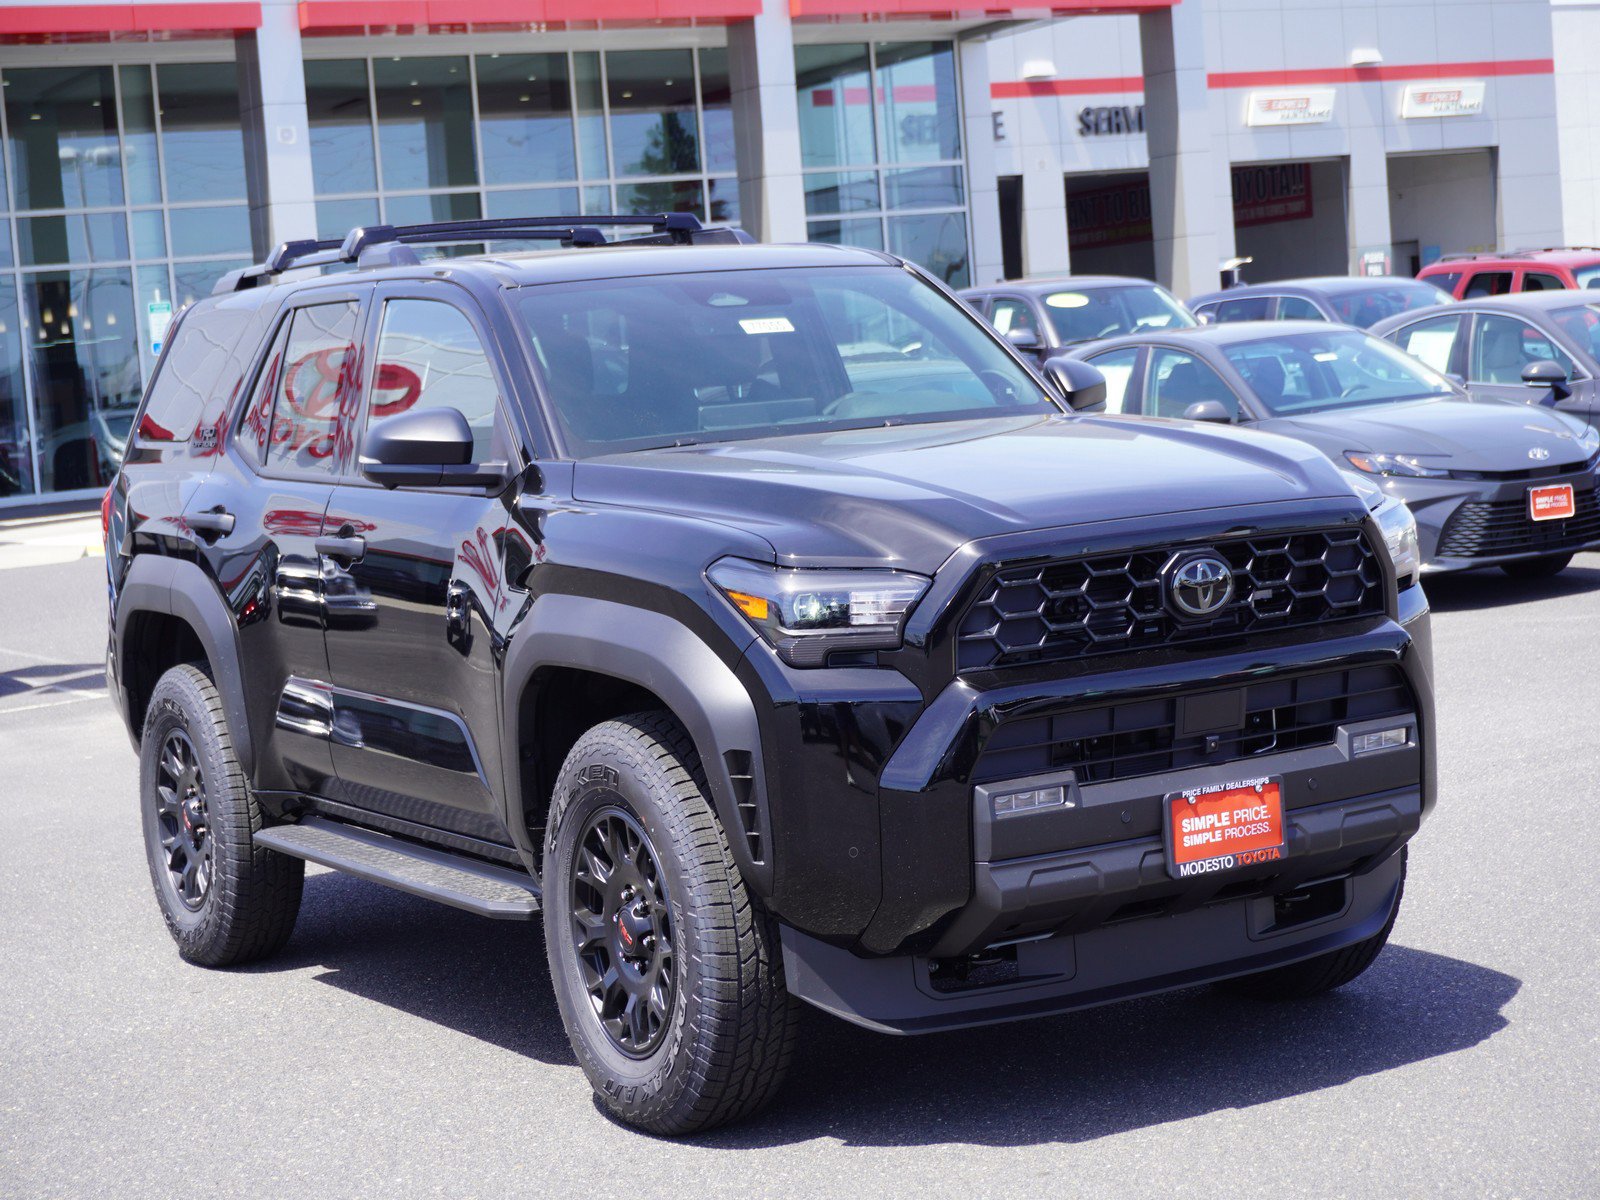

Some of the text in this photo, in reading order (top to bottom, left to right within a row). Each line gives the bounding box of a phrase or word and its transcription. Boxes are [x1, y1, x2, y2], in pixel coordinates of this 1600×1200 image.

[1182, 777, 1270, 798] PRICE FAMILY DEALERSHIPS
[1181, 805, 1271, 833] SIMPLE PRICE.
[1183, 822, 1272, 847] SIMPLE PROCESS.
[1180, 848, 1280, 877] MODESTO TOYOTA
